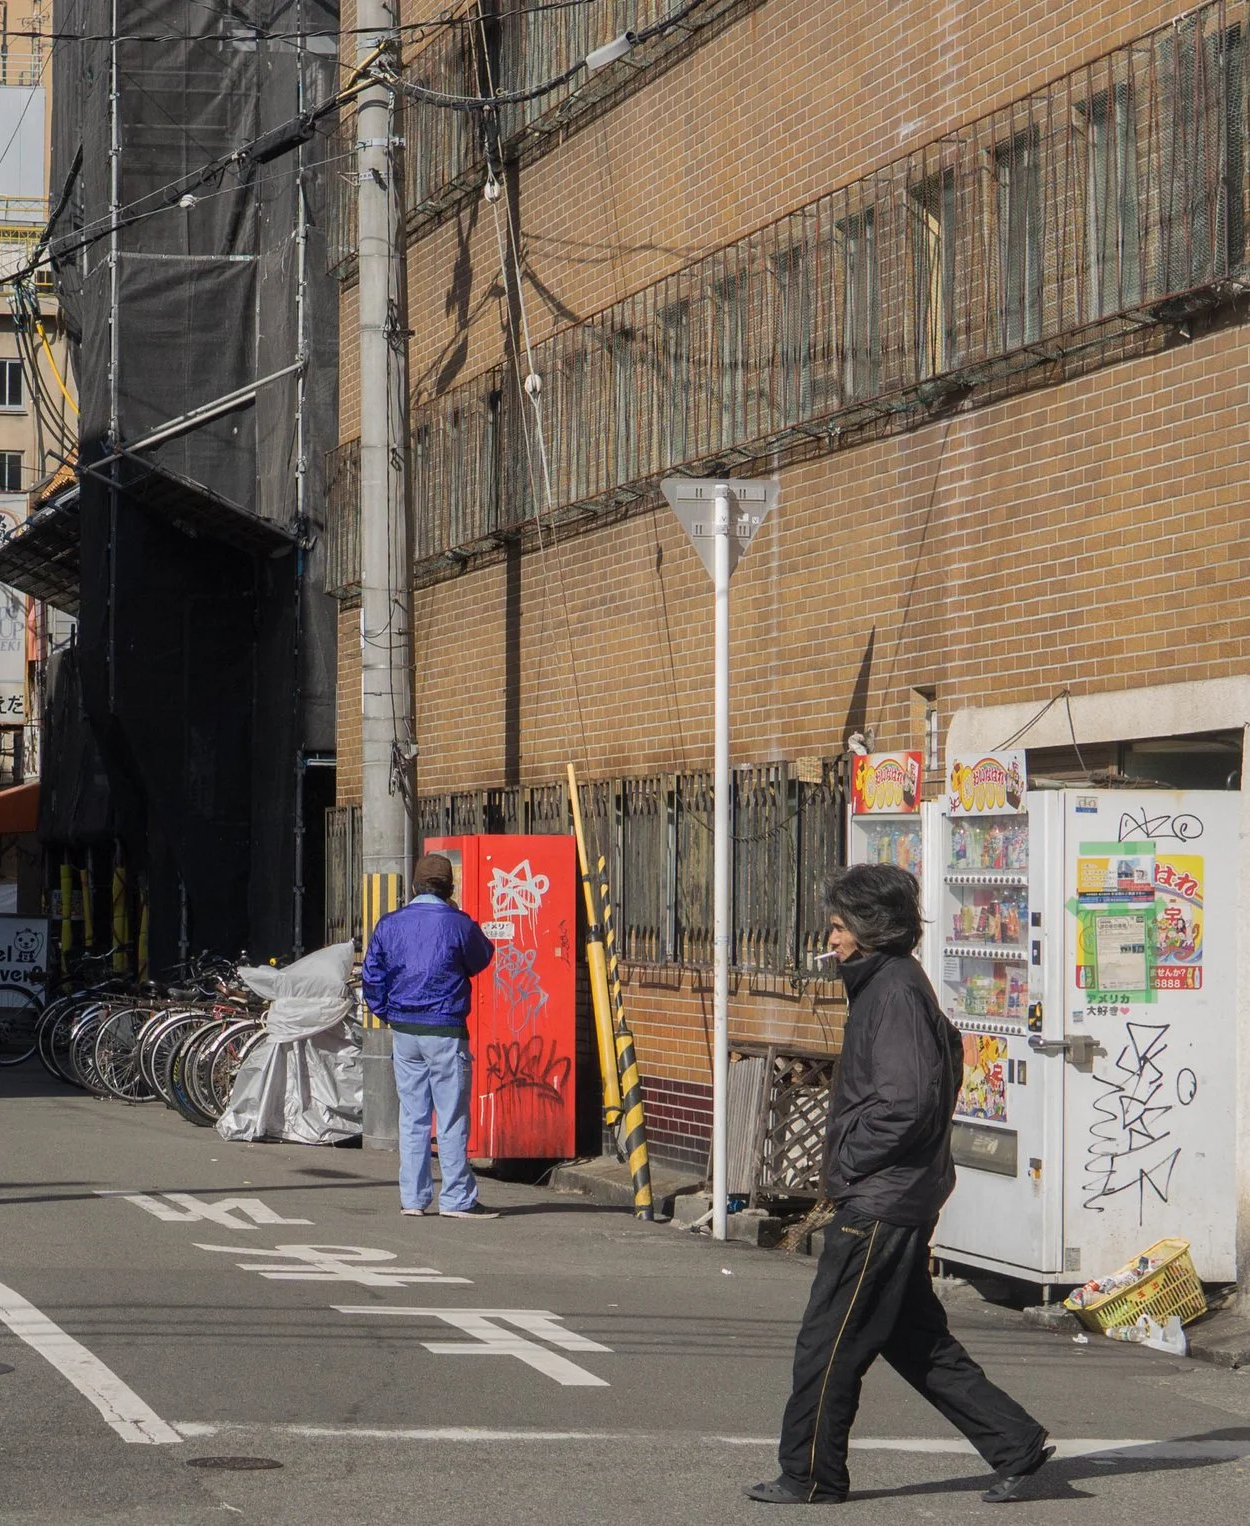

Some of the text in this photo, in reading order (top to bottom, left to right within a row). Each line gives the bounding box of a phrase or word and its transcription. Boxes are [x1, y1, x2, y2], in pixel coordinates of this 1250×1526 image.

[1086, 993, 1130, 1004] アメリカ
[1086, 1005, 1119, 1016] 大好き
[92, 1189, 615, 1387] 止まれ
